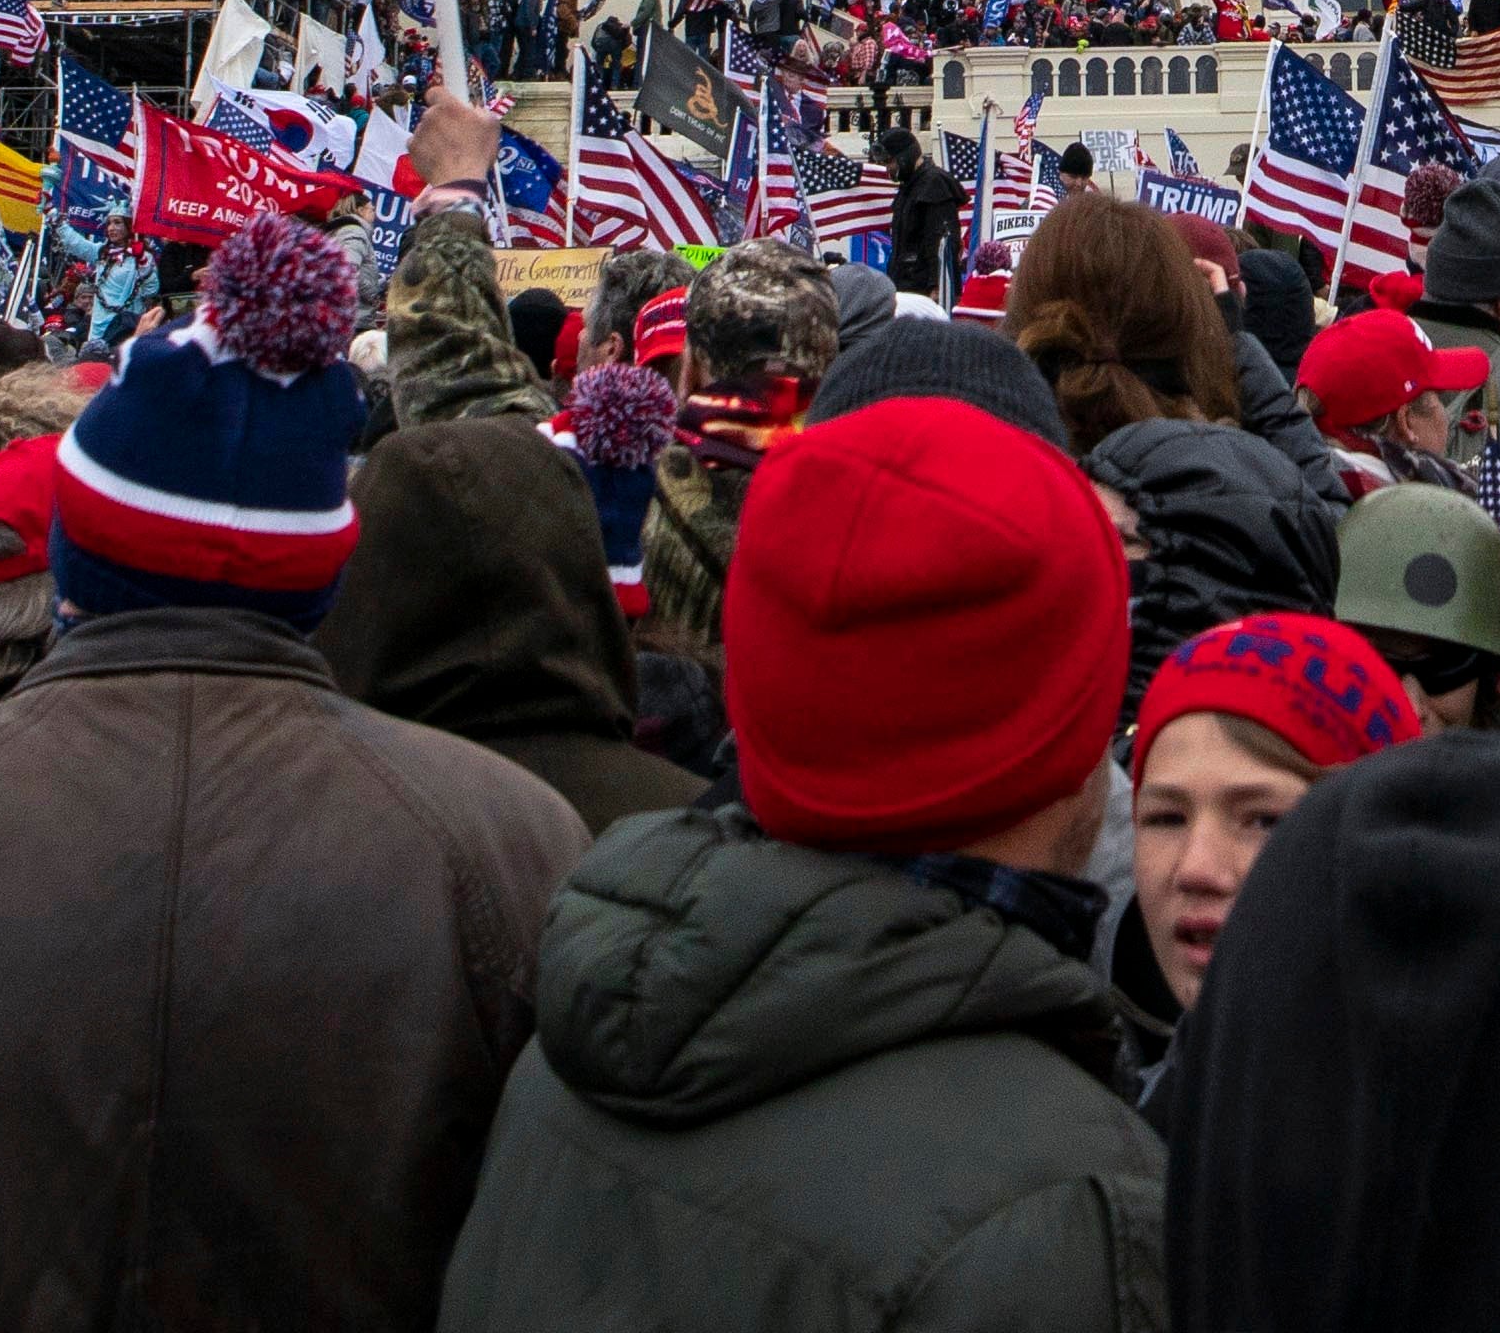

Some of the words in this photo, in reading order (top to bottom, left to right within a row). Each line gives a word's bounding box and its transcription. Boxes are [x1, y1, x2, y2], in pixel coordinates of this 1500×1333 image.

[1085, 131, 1129, 148] SEND
[498, 145, 537, 176] 2ND
[167, 197, 210, 217] KEEP
[1147, 182, 1240, 225] TRUMP
[996, 215, 1035, 233] BIKERS
[498, 257, 526, 283] The
